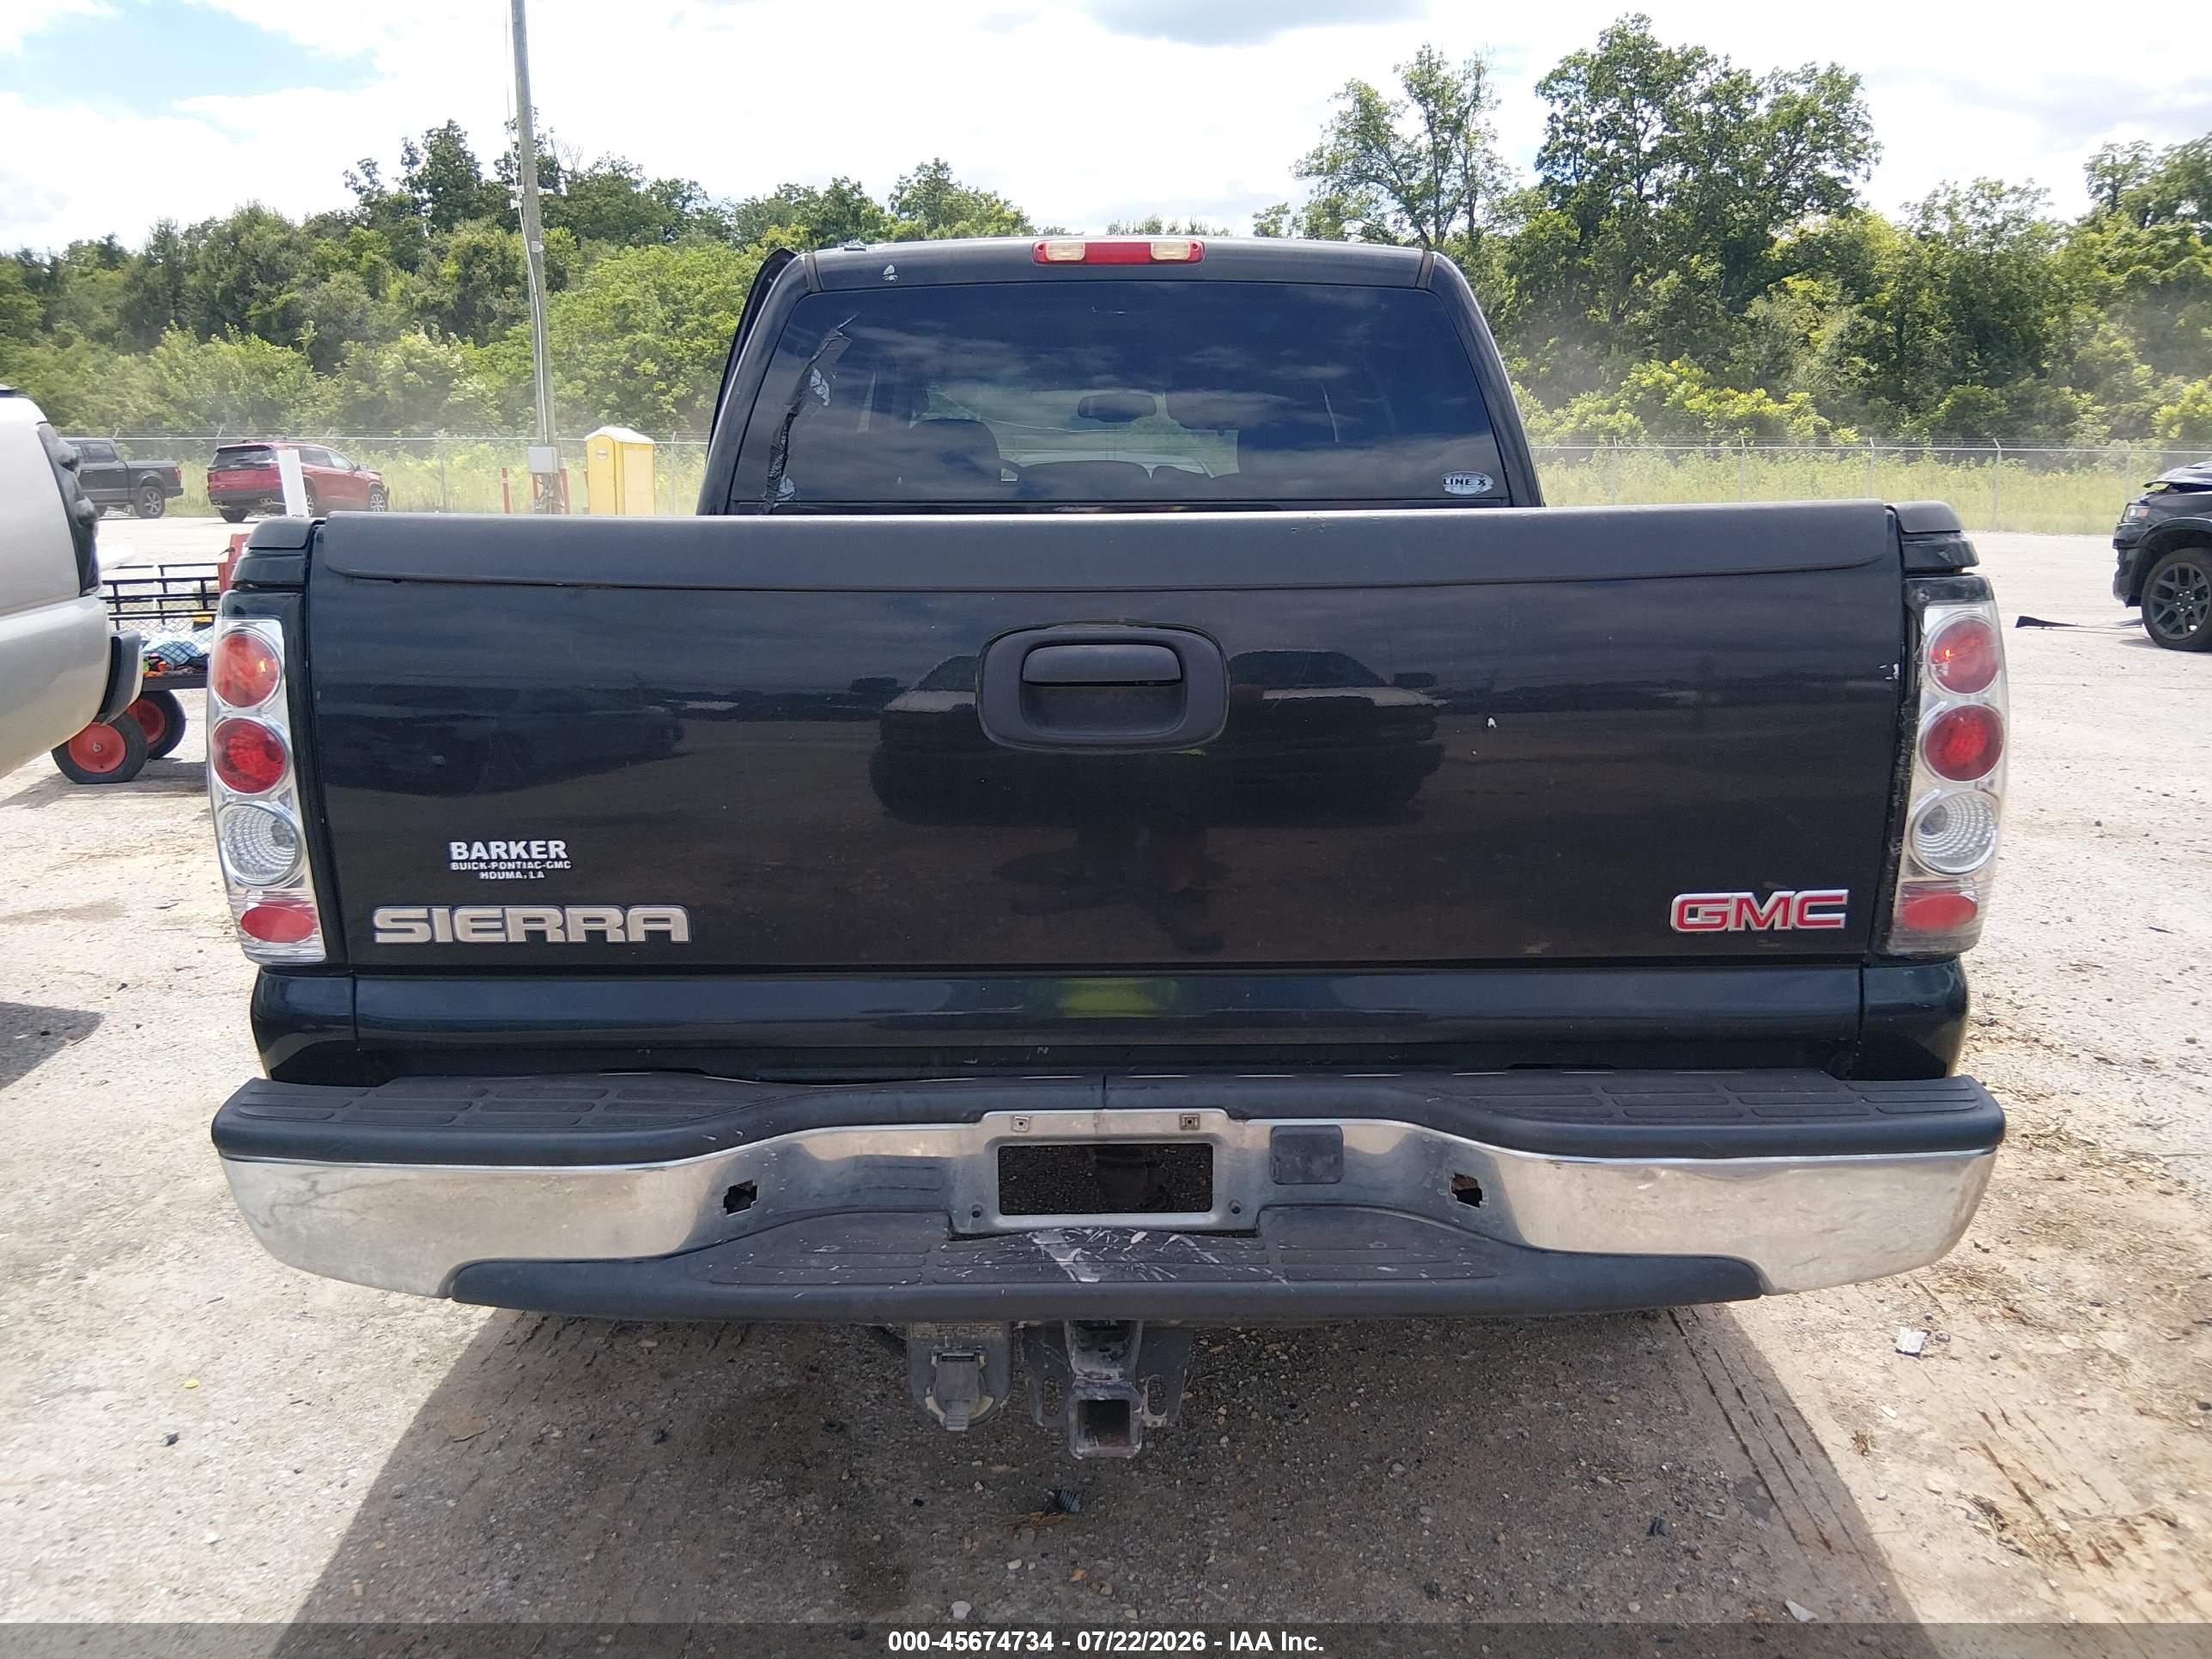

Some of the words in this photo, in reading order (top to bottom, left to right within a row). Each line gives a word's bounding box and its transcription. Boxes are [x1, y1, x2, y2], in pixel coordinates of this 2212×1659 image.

[450, 840, 568, 860] BARKER
[450, 860, 572, 871] BUICK-PONTIAC-GMC
[529, 871, 545, 879] LA
[1670, 889, 1849, 933] GMC
[372, 905, 691, 944] SIERRA
